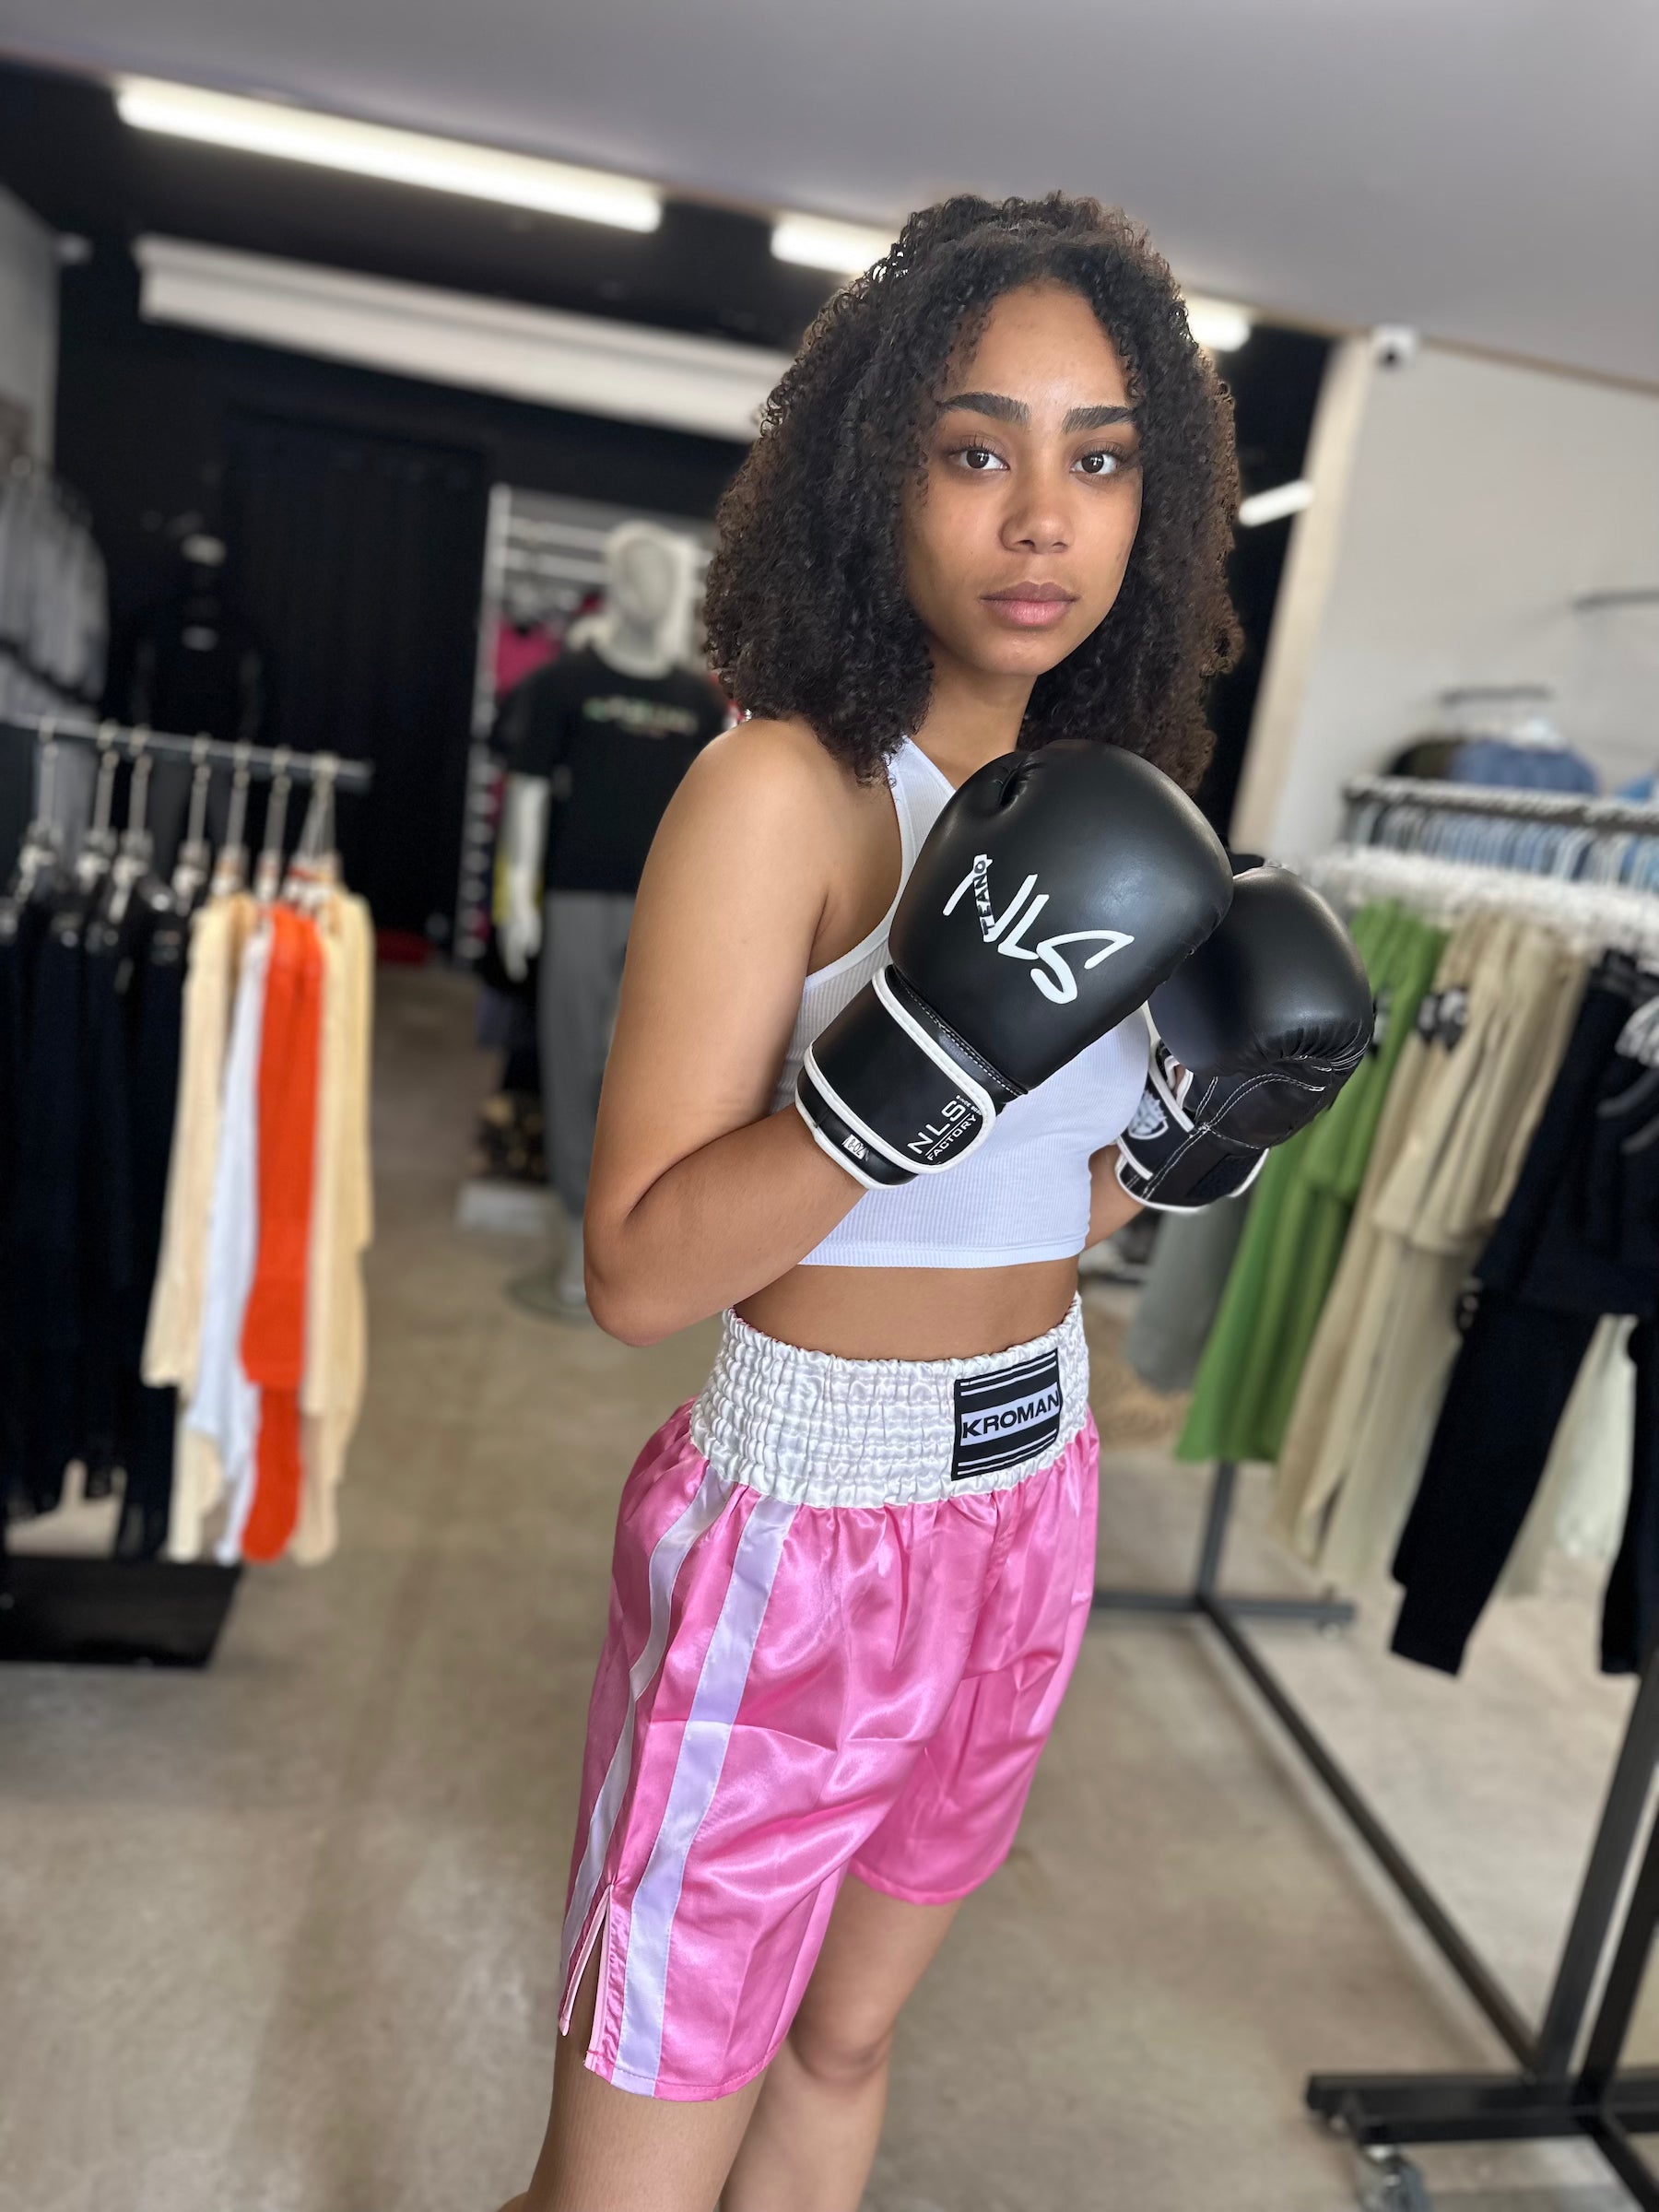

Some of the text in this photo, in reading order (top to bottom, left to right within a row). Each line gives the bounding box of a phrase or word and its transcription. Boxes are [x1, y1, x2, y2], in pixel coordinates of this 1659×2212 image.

[943, 853, 1135, 1004] NLS
[907, 1100, 966, 1154] NLS
[927, 1114, 976, 1160] FACTORY
[963, 1391, 1059, 1438] KROMAN
